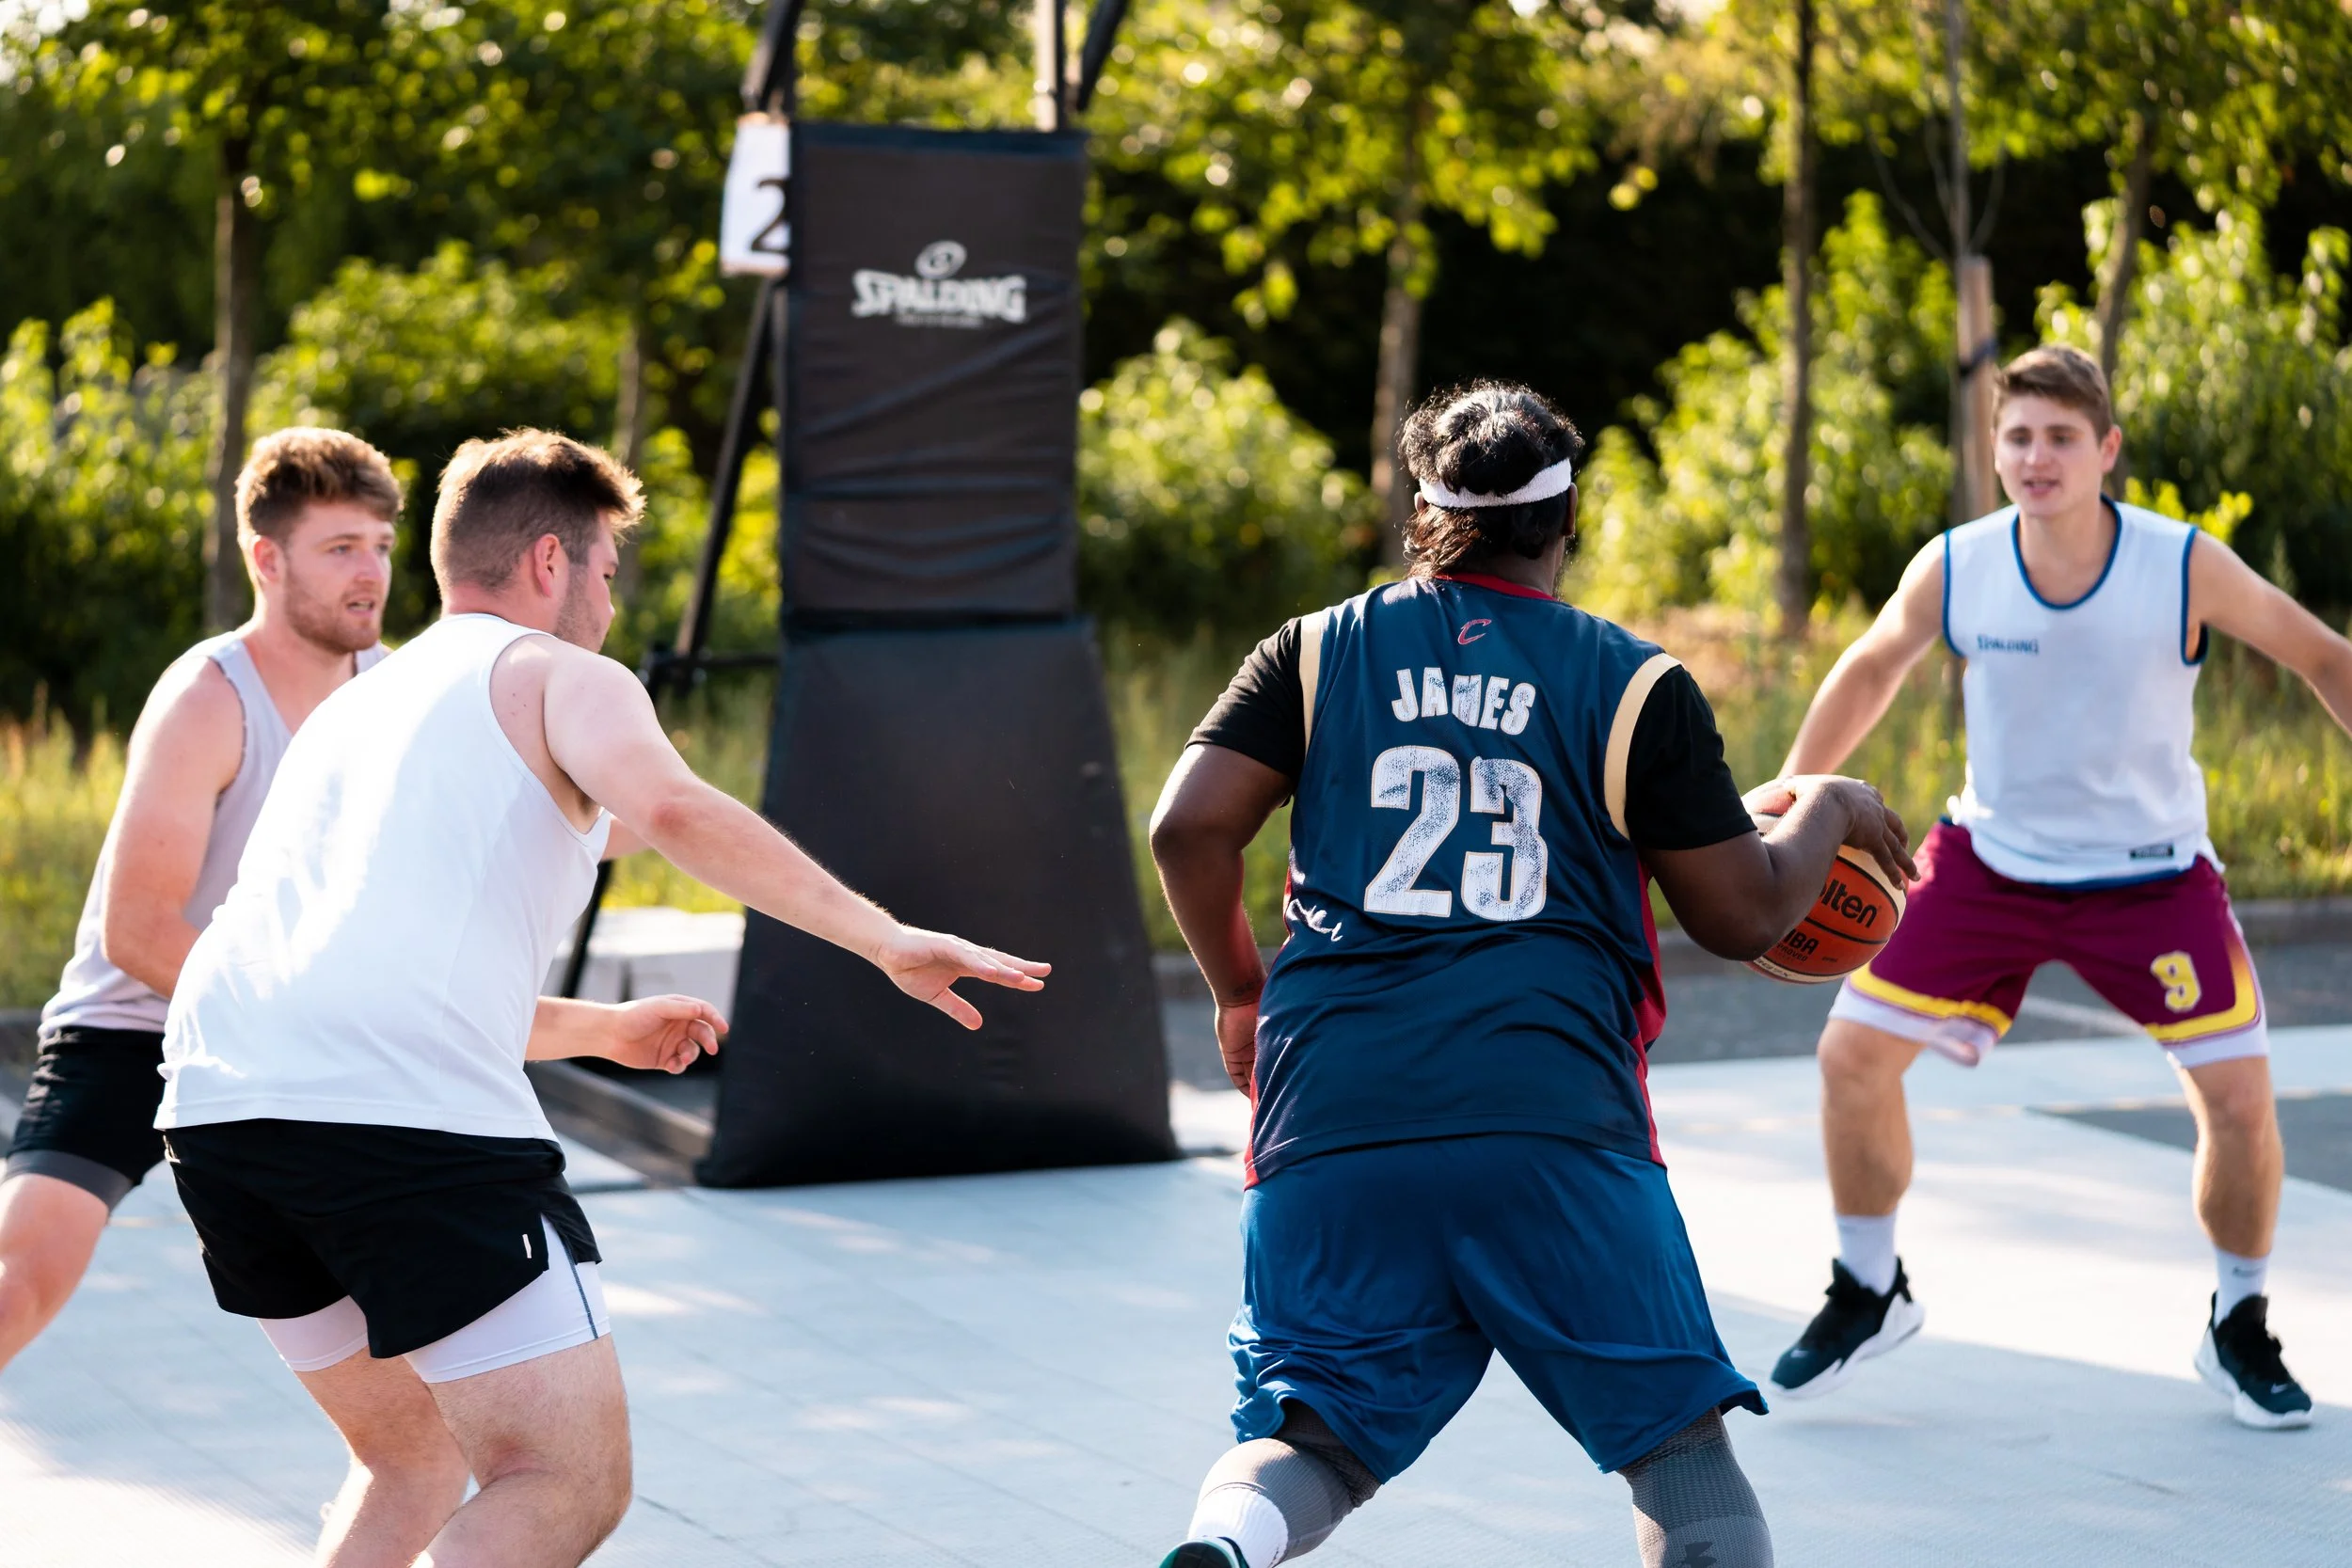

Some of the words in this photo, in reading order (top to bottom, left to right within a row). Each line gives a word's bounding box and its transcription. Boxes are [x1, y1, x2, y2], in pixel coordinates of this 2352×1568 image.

[751, 178, 787, 253] 2
[850, 269, 1027, 324] SPALDING
[1391, 667, 1537, 736] JAMES
[1363, 745, 1549, 922] 23
[1820, 879, 1878, 928] lten
[1775, 942, 1809, 963] PROVED
[1783, 927, 1820, 956] IBA
[2150, 950, 2202, 1013] 9
